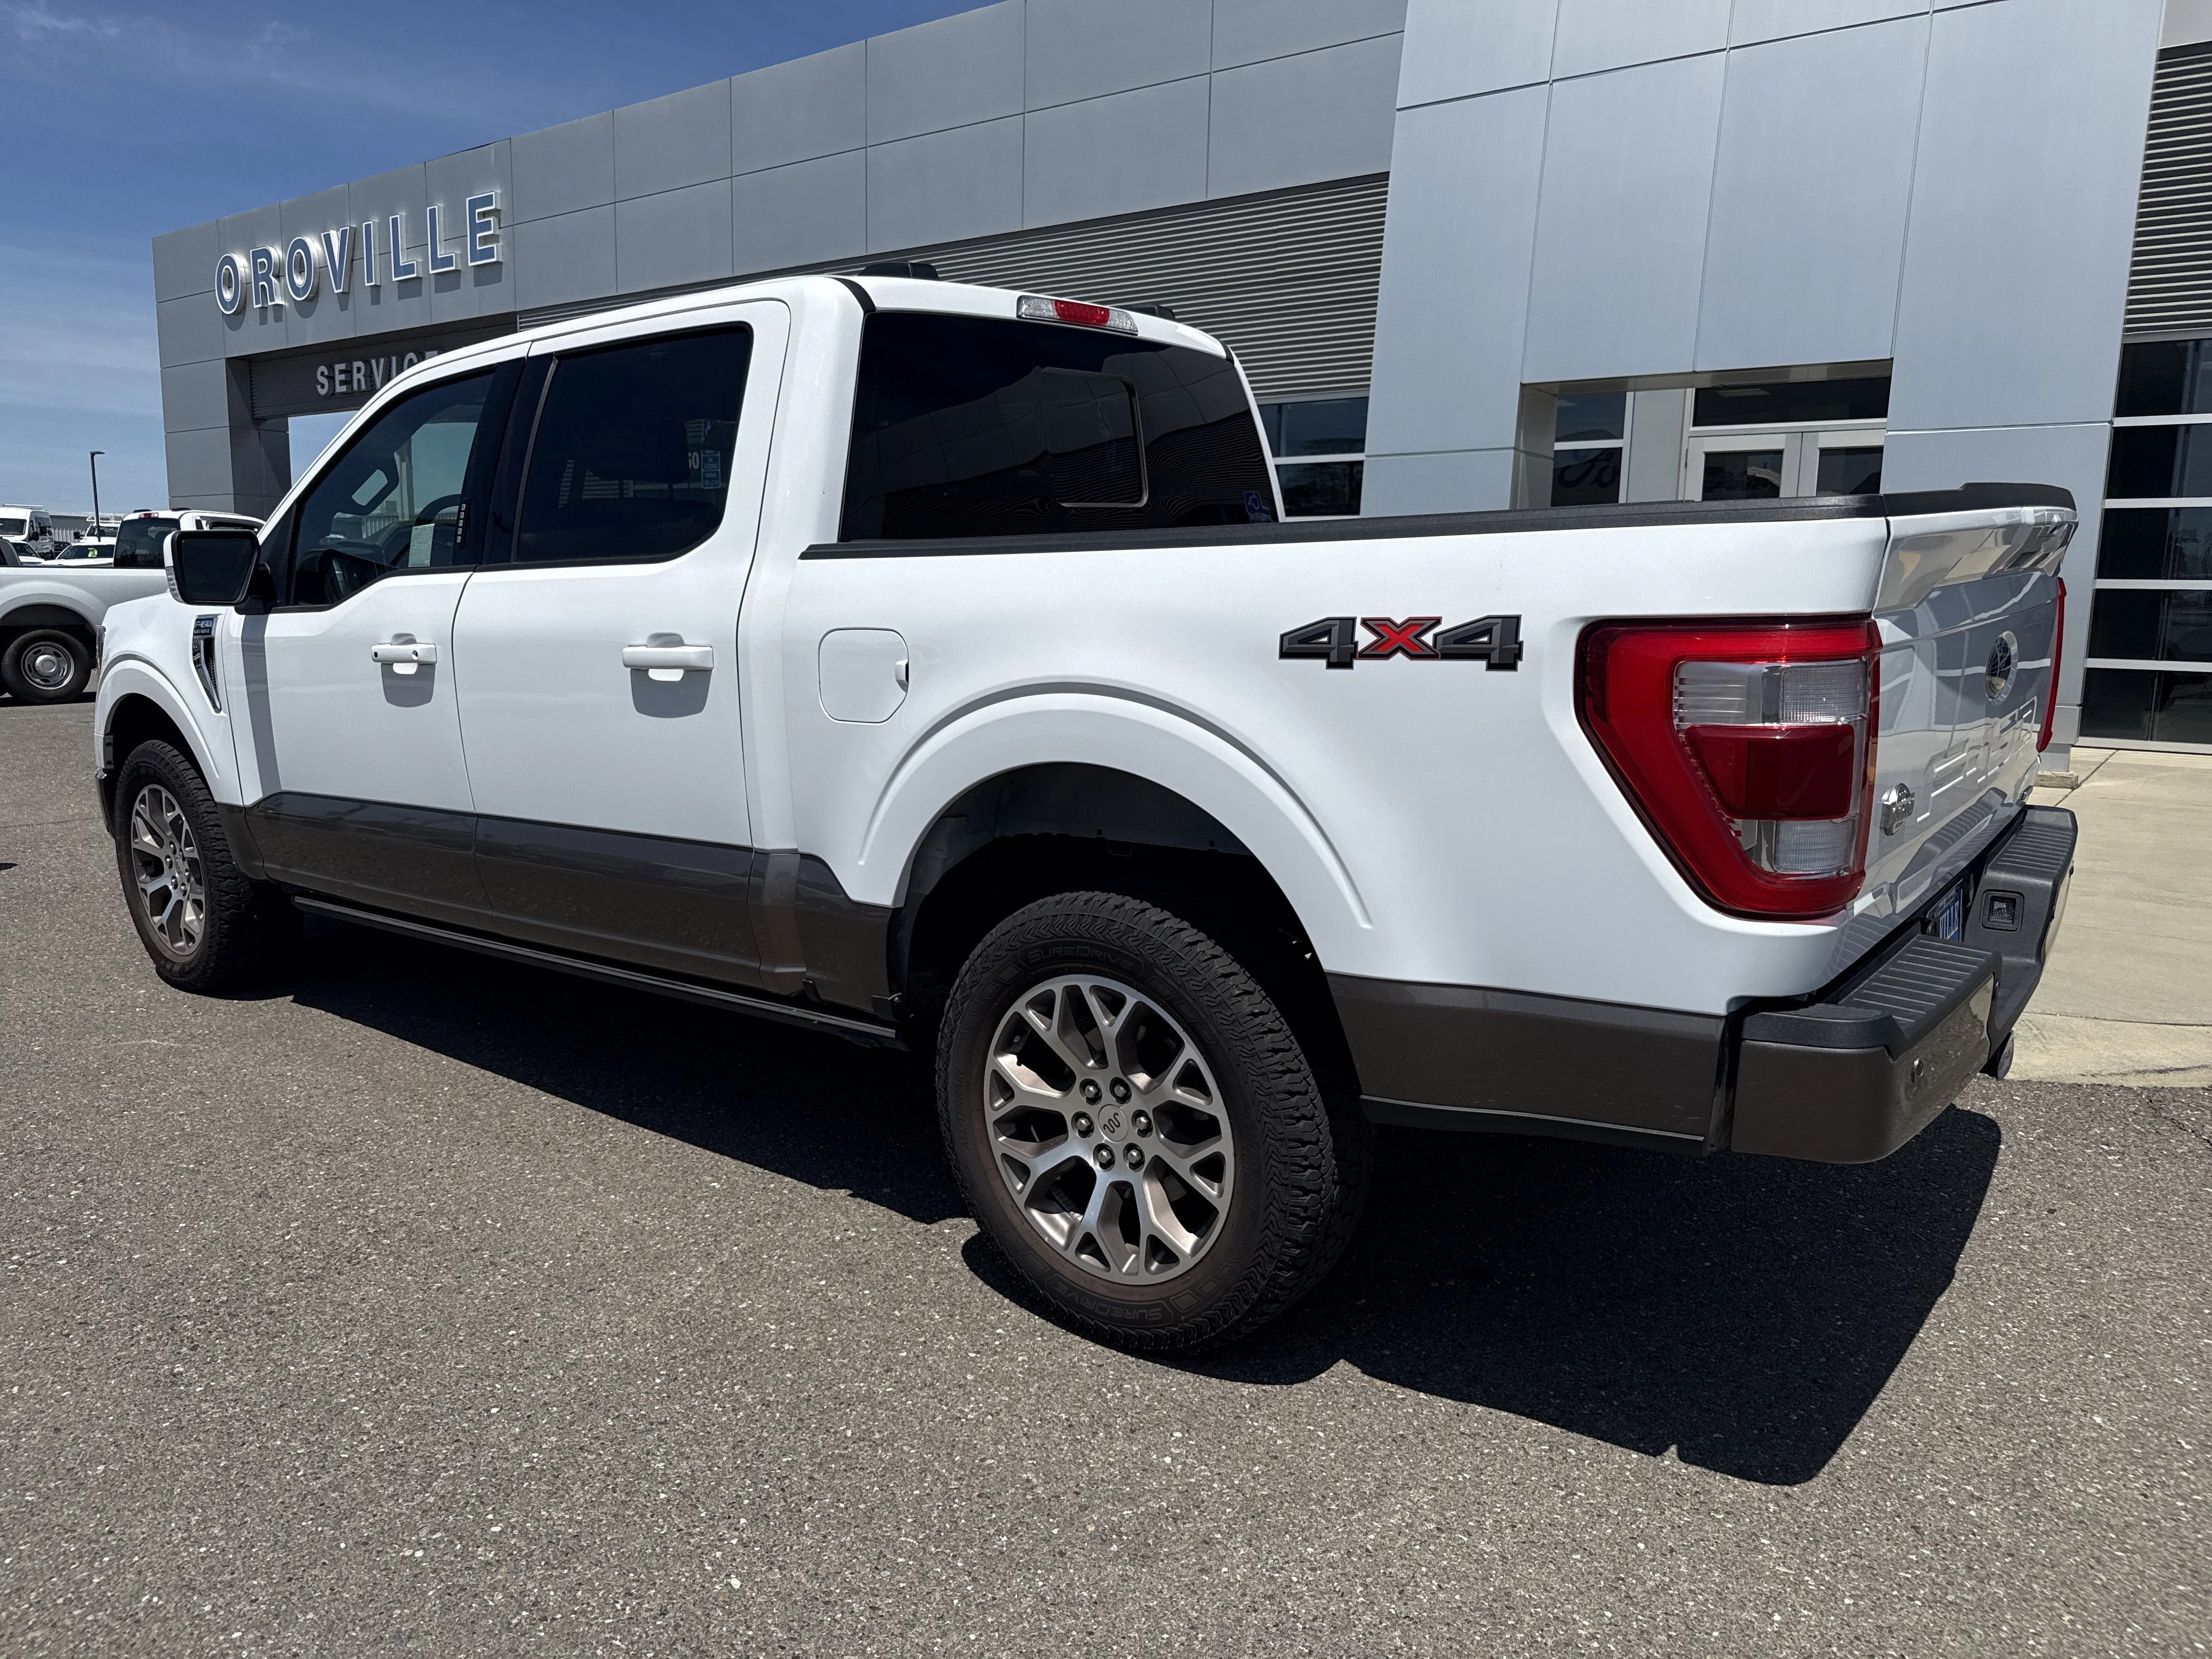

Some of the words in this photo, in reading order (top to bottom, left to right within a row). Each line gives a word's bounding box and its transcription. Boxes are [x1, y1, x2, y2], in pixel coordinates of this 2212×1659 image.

[215, 191, 503, 314] OROVILLE
[315, 350, 439, 397] SERVI
[1279, 614, 1524, 672] 4X4
